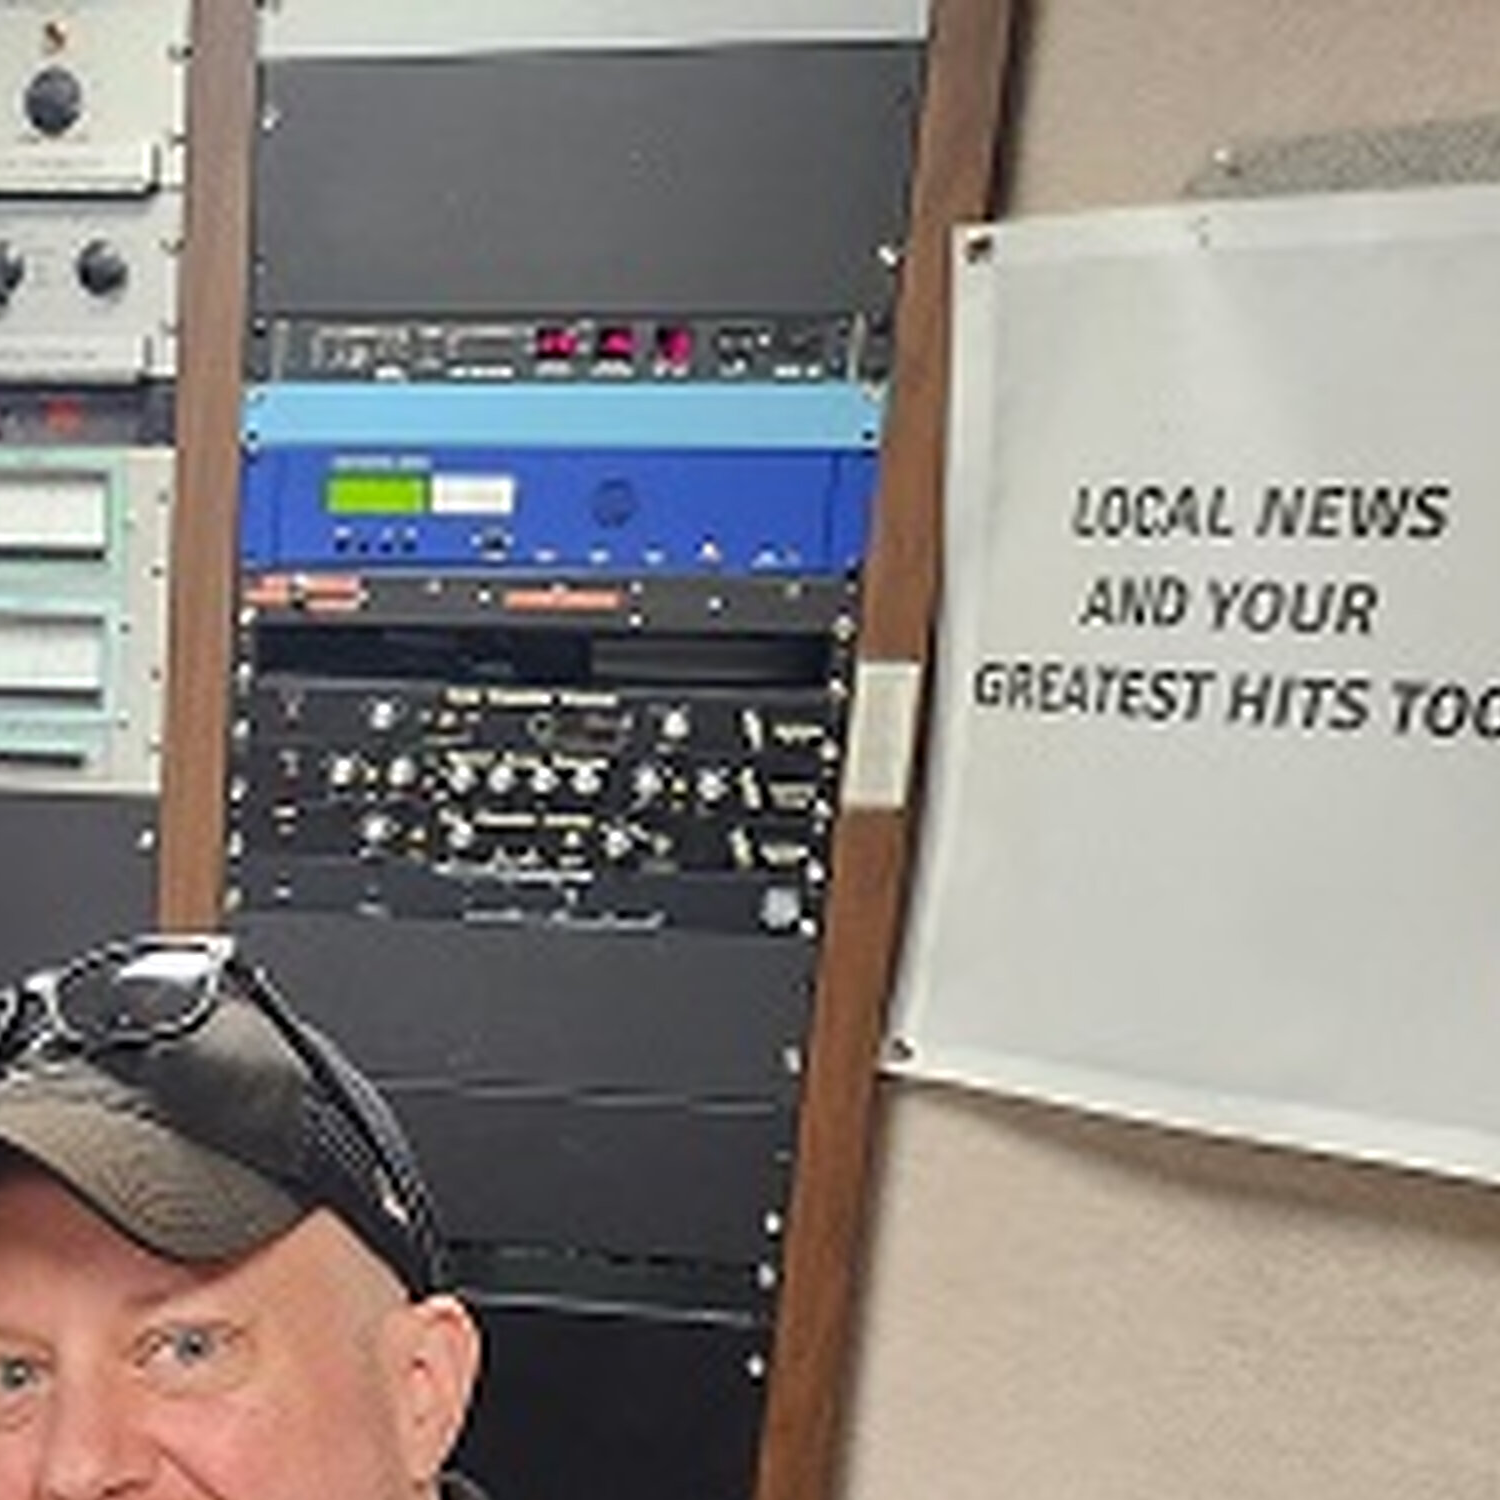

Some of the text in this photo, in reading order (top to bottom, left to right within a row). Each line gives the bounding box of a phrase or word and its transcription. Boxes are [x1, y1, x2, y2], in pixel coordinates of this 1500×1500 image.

[1071, 485, 1450, 539] LOCAL NEWS
[1077, 575, 1379, 635] AND YOUR
[973, 662, 1217, 722] GREATEST
[1225, 672, 1371, 731] HITS
